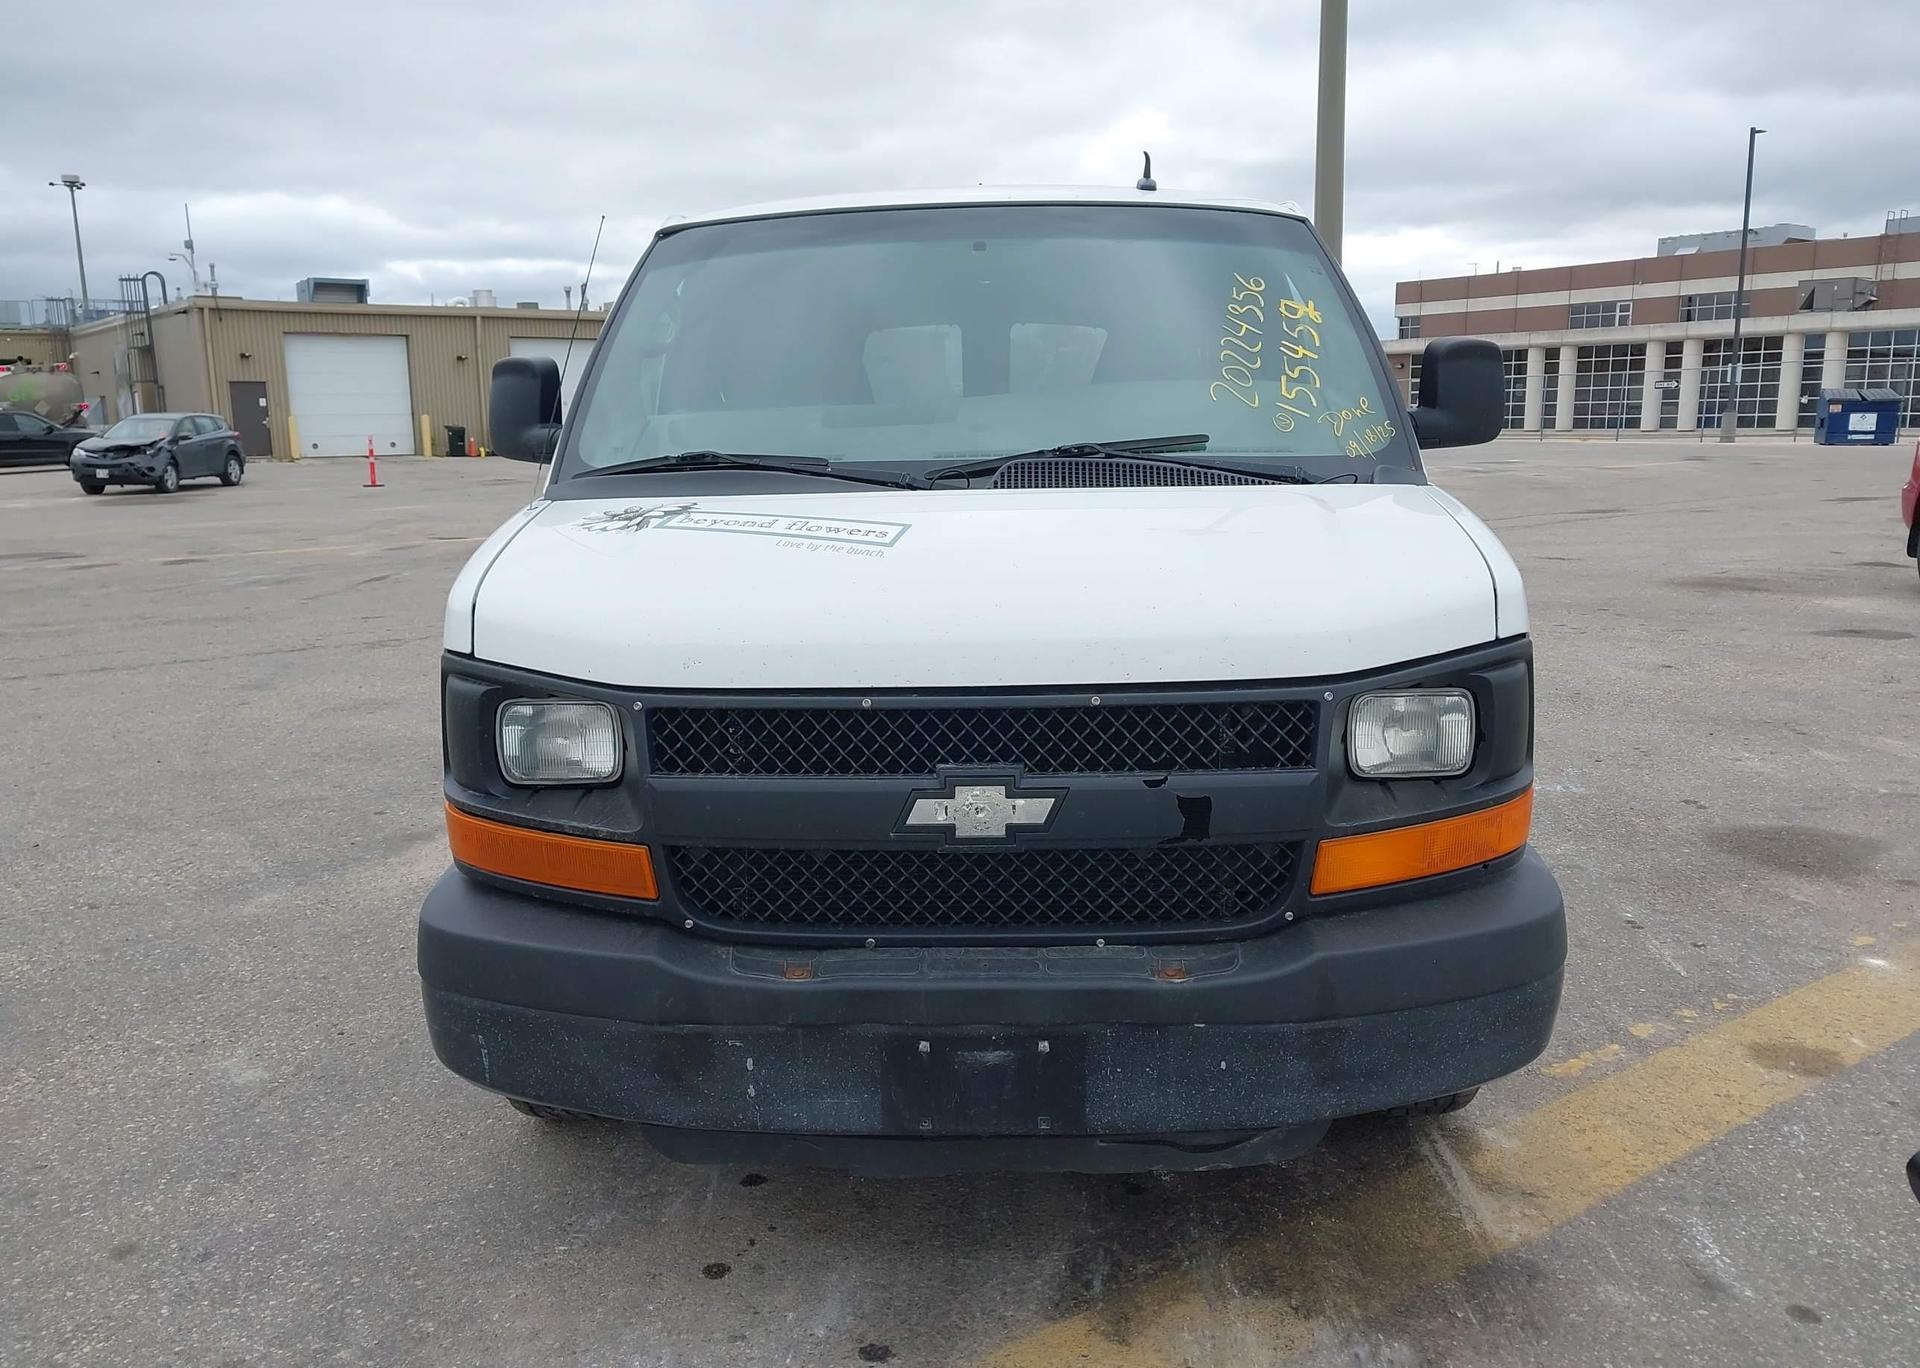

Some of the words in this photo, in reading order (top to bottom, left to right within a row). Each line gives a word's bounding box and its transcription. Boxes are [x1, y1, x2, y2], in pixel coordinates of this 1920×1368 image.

[1210, 272, 1266, 408] 20224356
[1317, 396, 1376, 437] Done
[1346, 420, 1396, 461] 09/18/25
[677, 511, 779, 528] beyond
[785, 520, 889, 538] flowers
[776, 539, 804, 549] Love
[807, 542, 822, 552] by
[824, 543, 845, 553] the
[846, 546, 886, 559] bunch.
